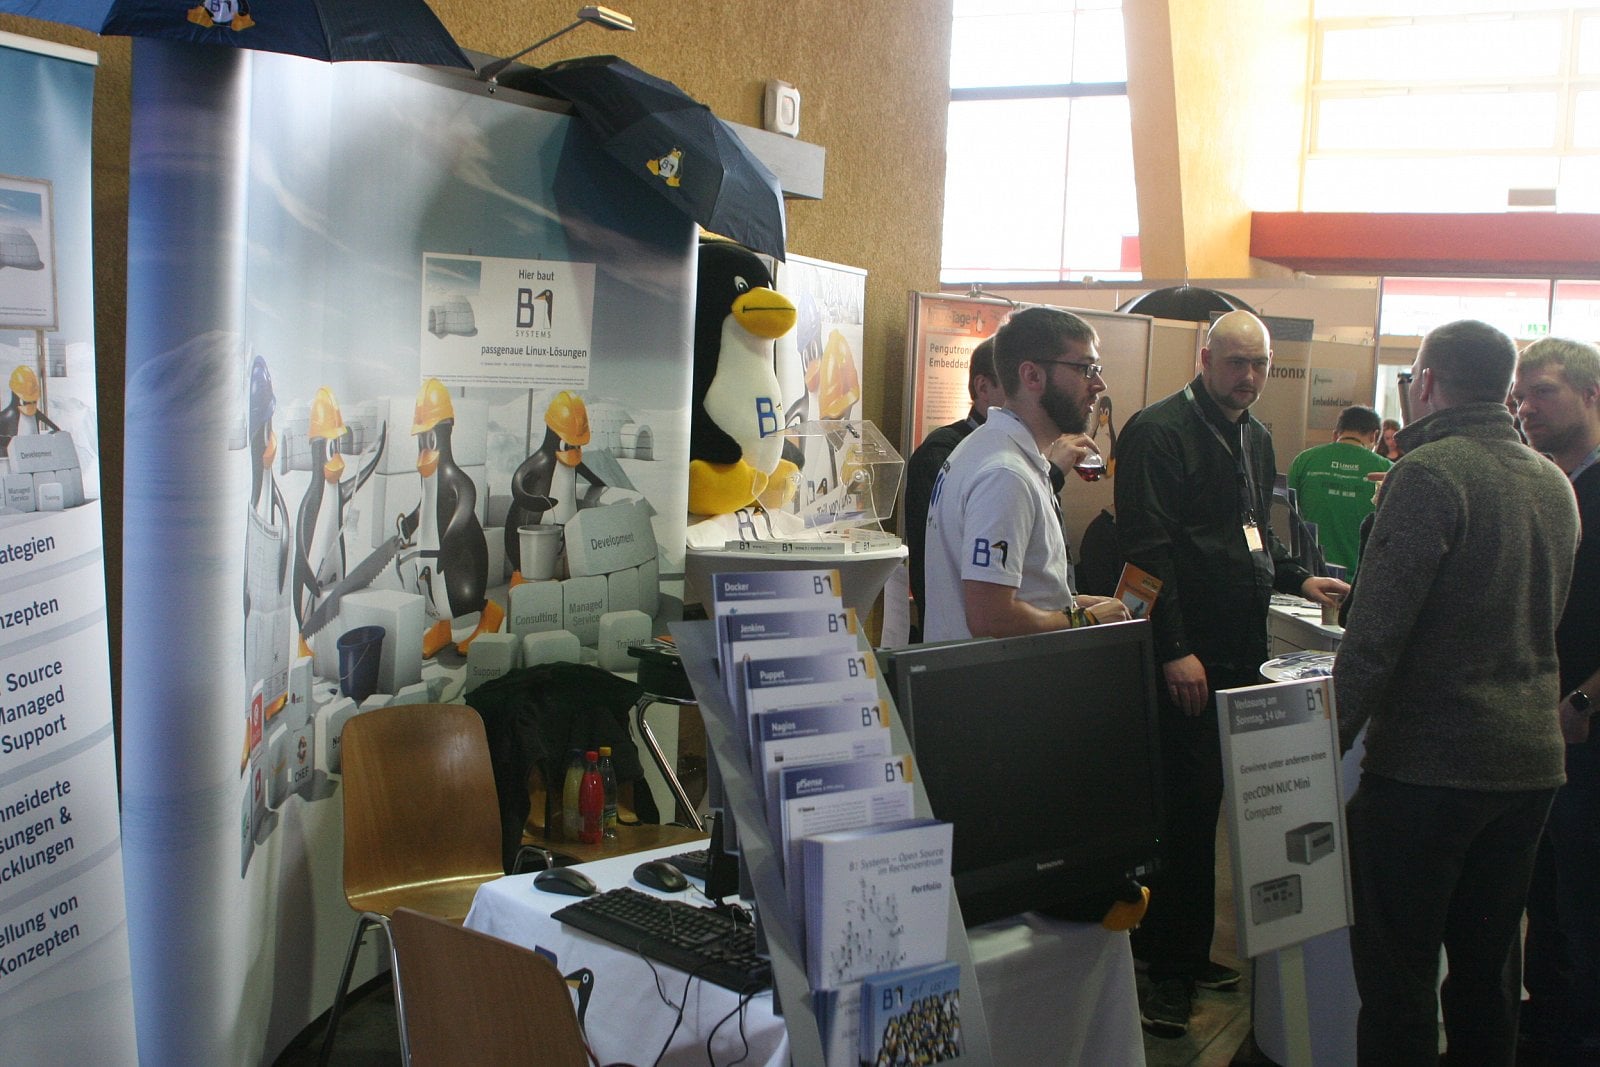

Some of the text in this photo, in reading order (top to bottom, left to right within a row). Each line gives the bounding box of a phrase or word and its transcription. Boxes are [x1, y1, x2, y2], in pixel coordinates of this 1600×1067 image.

[519, 269, 554, 281] Hier baut
[516, 288, 553, 329] B1
[516, 330, 551, 338] SYSTEMS
[481, 345, 587, 359] passgenaue Linux-Lösungen
[929, 358, 969, 369] Embedded
[591, 532, 634, 550] Development
[972, 538, 1008, 569] B1
[725, 575, 832, 594] Docker B1
[569, 599, 603, 614] Managed
[516, 612, 558, 626] Consulting
[741, 613, 848, 633] Jenkins B1
[6, 660, 62, 692] Source
[760, 669, 785, 681] Puppet
[848, 657, 866, 677] B1
[771, 722, 796, 733] Nagios
[862, 706, 881, 727] B1
[1, 714, 67, 754] Support
[885, 761, 904, 782] B1
[1276, 780, 1293, 794] NUC
[1294, 776, 1311, 791] Mini
[60, 806, 72, 825] &
[1245, 805, 1283, 821] Computer
[899, 851, 918, 862] Open
[920, 848, 943, 858] Source
[912, 881, 942, 894] Portfolio
[50, 895, 78, 919] von
